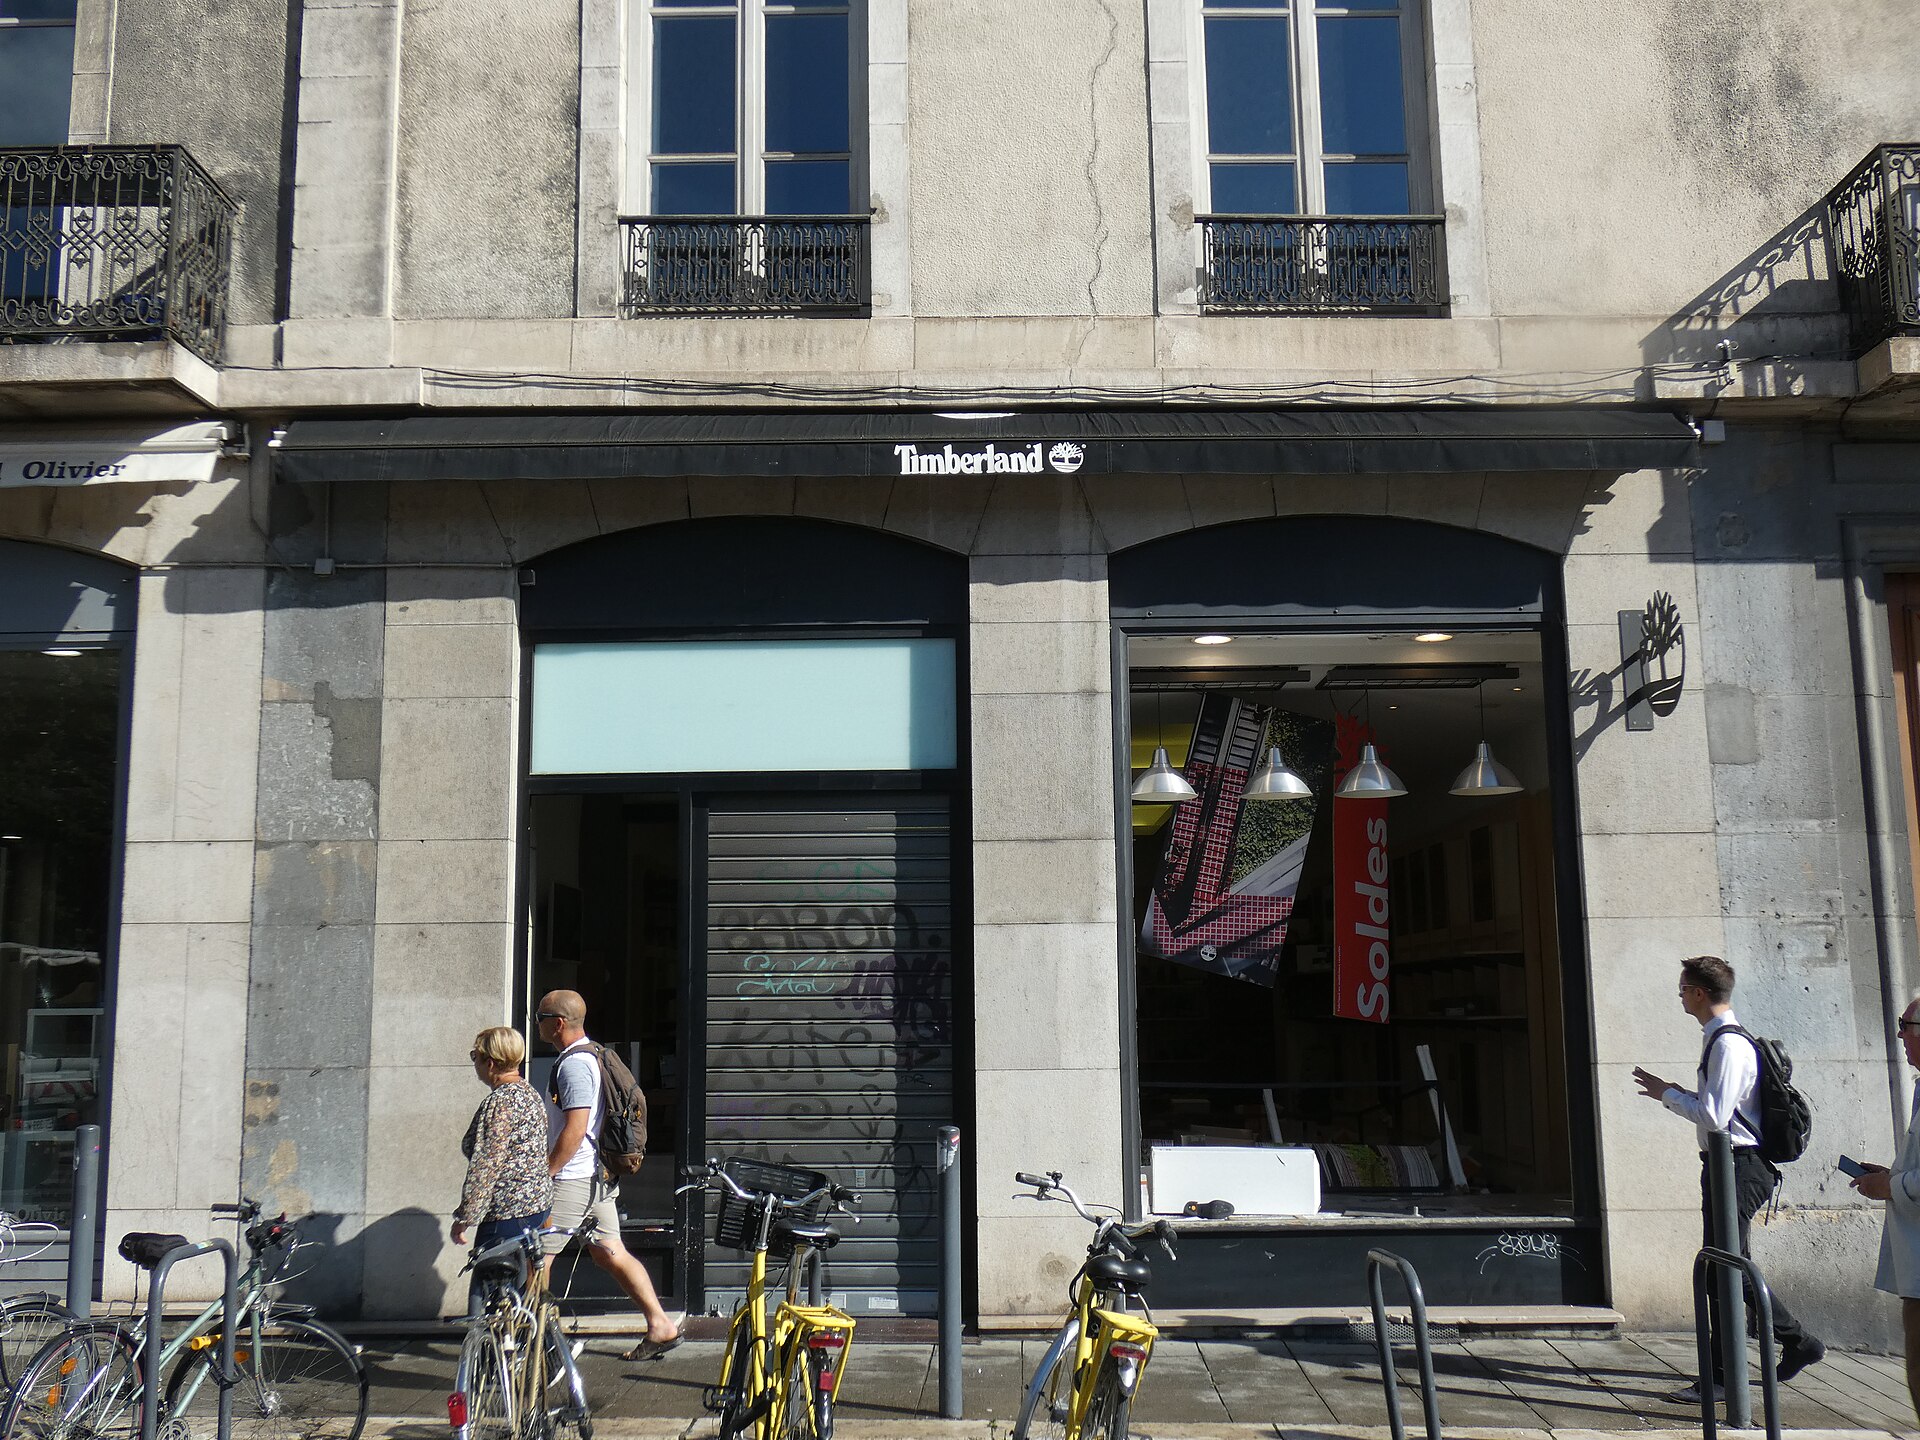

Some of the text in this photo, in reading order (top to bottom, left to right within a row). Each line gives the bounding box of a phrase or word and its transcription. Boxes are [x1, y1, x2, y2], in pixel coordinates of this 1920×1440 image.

[22, 461, 126, 480] Olivier
[893, 442, 1044, 475] Timberland
[1354, 816, 1390, 1024] Soldes
